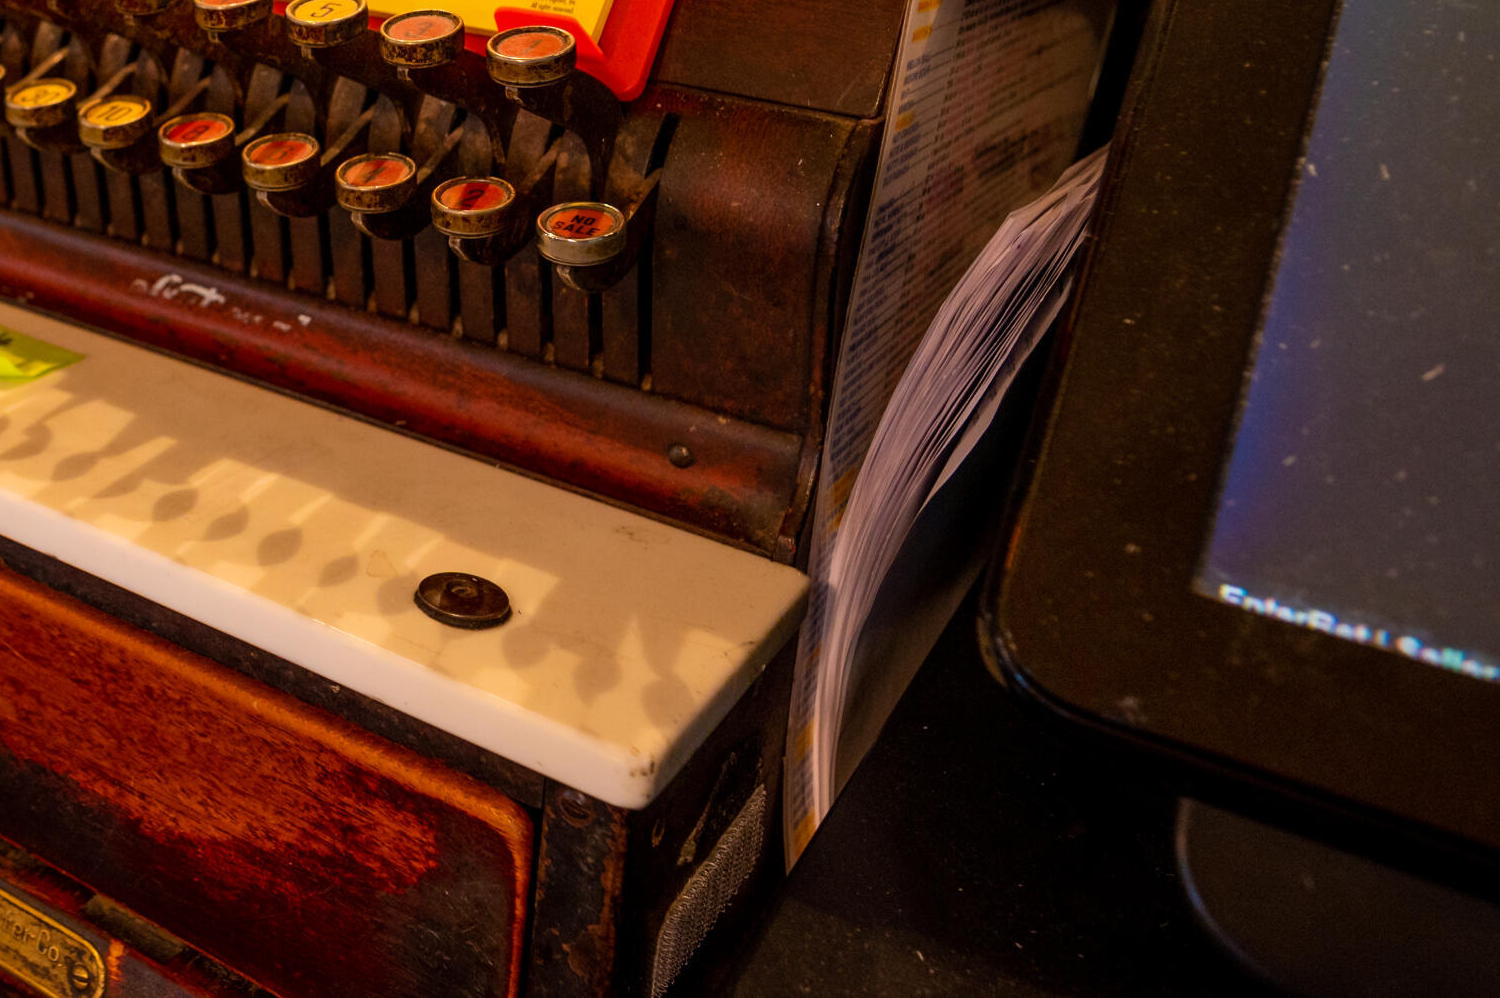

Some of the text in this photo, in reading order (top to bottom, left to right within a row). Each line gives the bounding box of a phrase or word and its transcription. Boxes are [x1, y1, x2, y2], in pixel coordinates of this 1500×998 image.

[309, 2, 342, 21] 5
[411, 20, 437, 39] 3
[553, 221, 601, 237] SALE
[571, 215, 596, 226] NO
